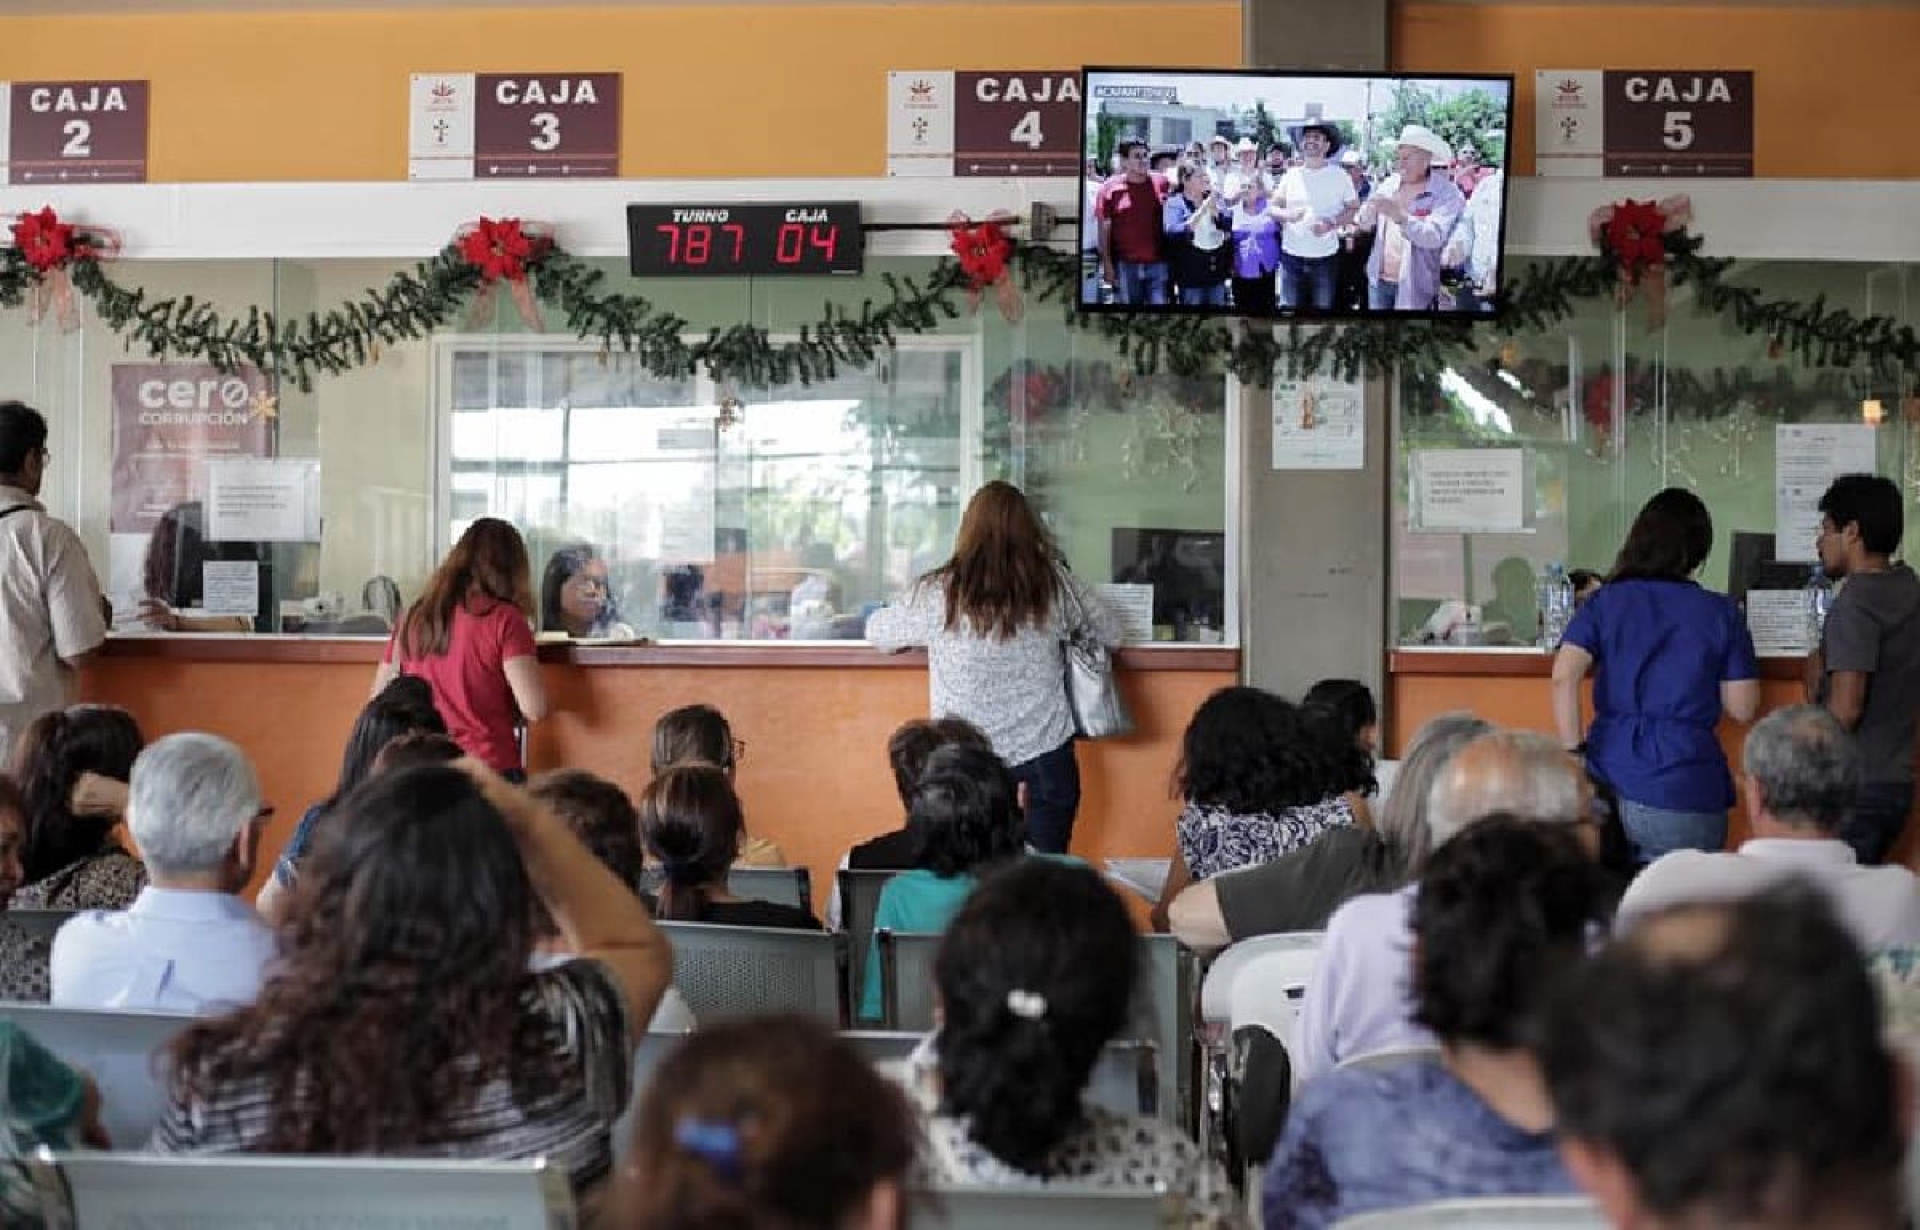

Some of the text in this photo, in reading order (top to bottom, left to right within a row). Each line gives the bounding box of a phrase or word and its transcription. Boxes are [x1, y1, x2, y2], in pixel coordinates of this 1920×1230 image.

[31, 87, 128, 113] CAJA
[496, 79, 599, 105] CAJA
[976, 76, 1081, 102] CAJA
[1624, 77, 1732, 103] CAJA
[62, 119, 91, 158] 2
[529, 111, 562, 151] 3
[1010, 111, 1044, 149] 4
[1662, 111, 1695, 150] 5
[672, 208, 730, 223] TURNO
[784, 208, 829, 223] CAJA
[656, 223, 745, 264] 787
[776, 223, 840, 264] 04
